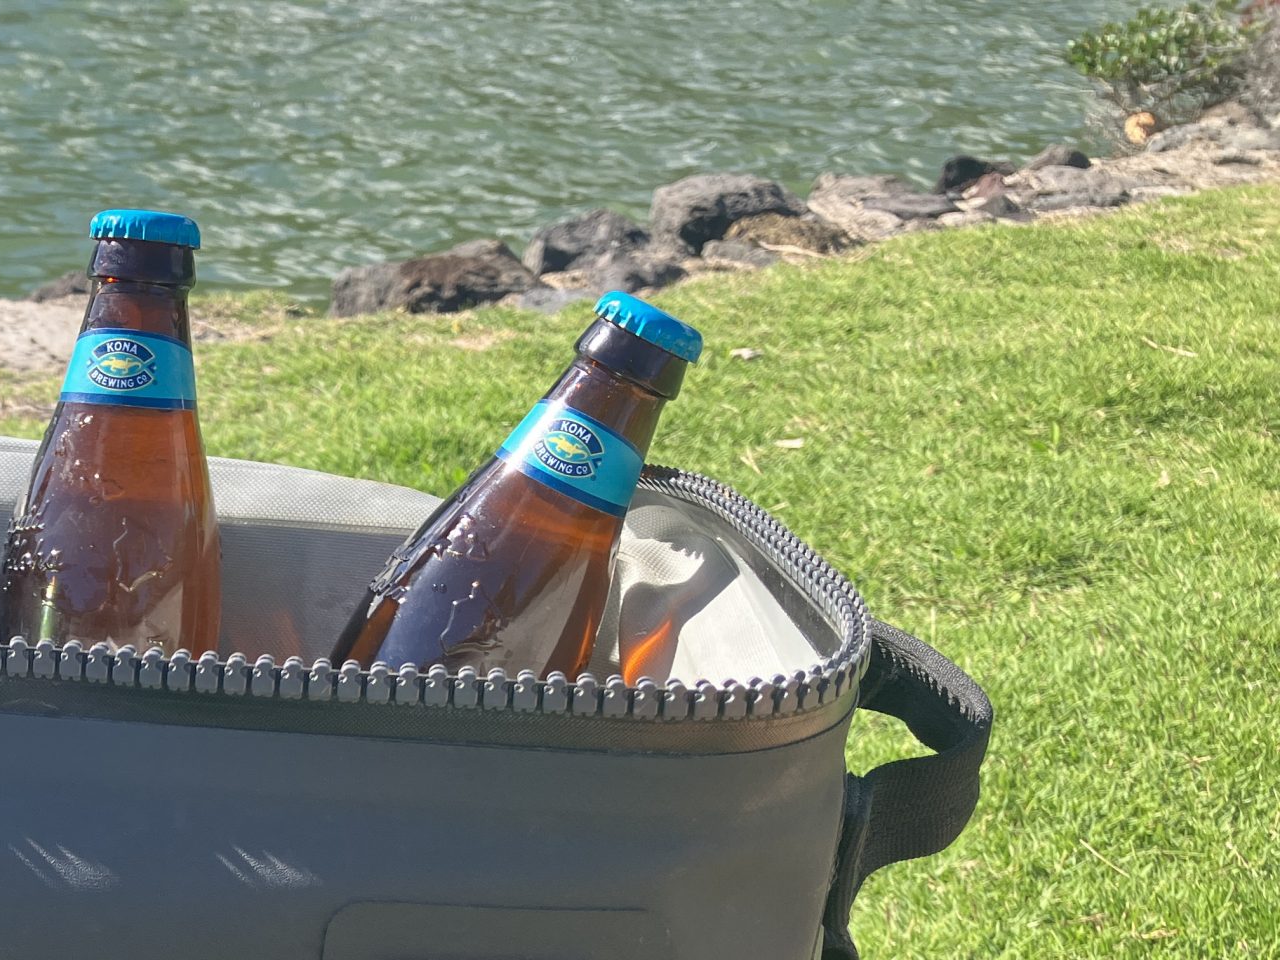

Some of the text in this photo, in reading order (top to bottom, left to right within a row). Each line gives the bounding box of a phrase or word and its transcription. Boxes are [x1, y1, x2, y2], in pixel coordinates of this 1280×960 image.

[106, 341, 138, 355] KONA
[91, 369, 134, 388] BREWING
[560, 420, 592, 444] KONA
[535, 441, 573, 475] BREWING
